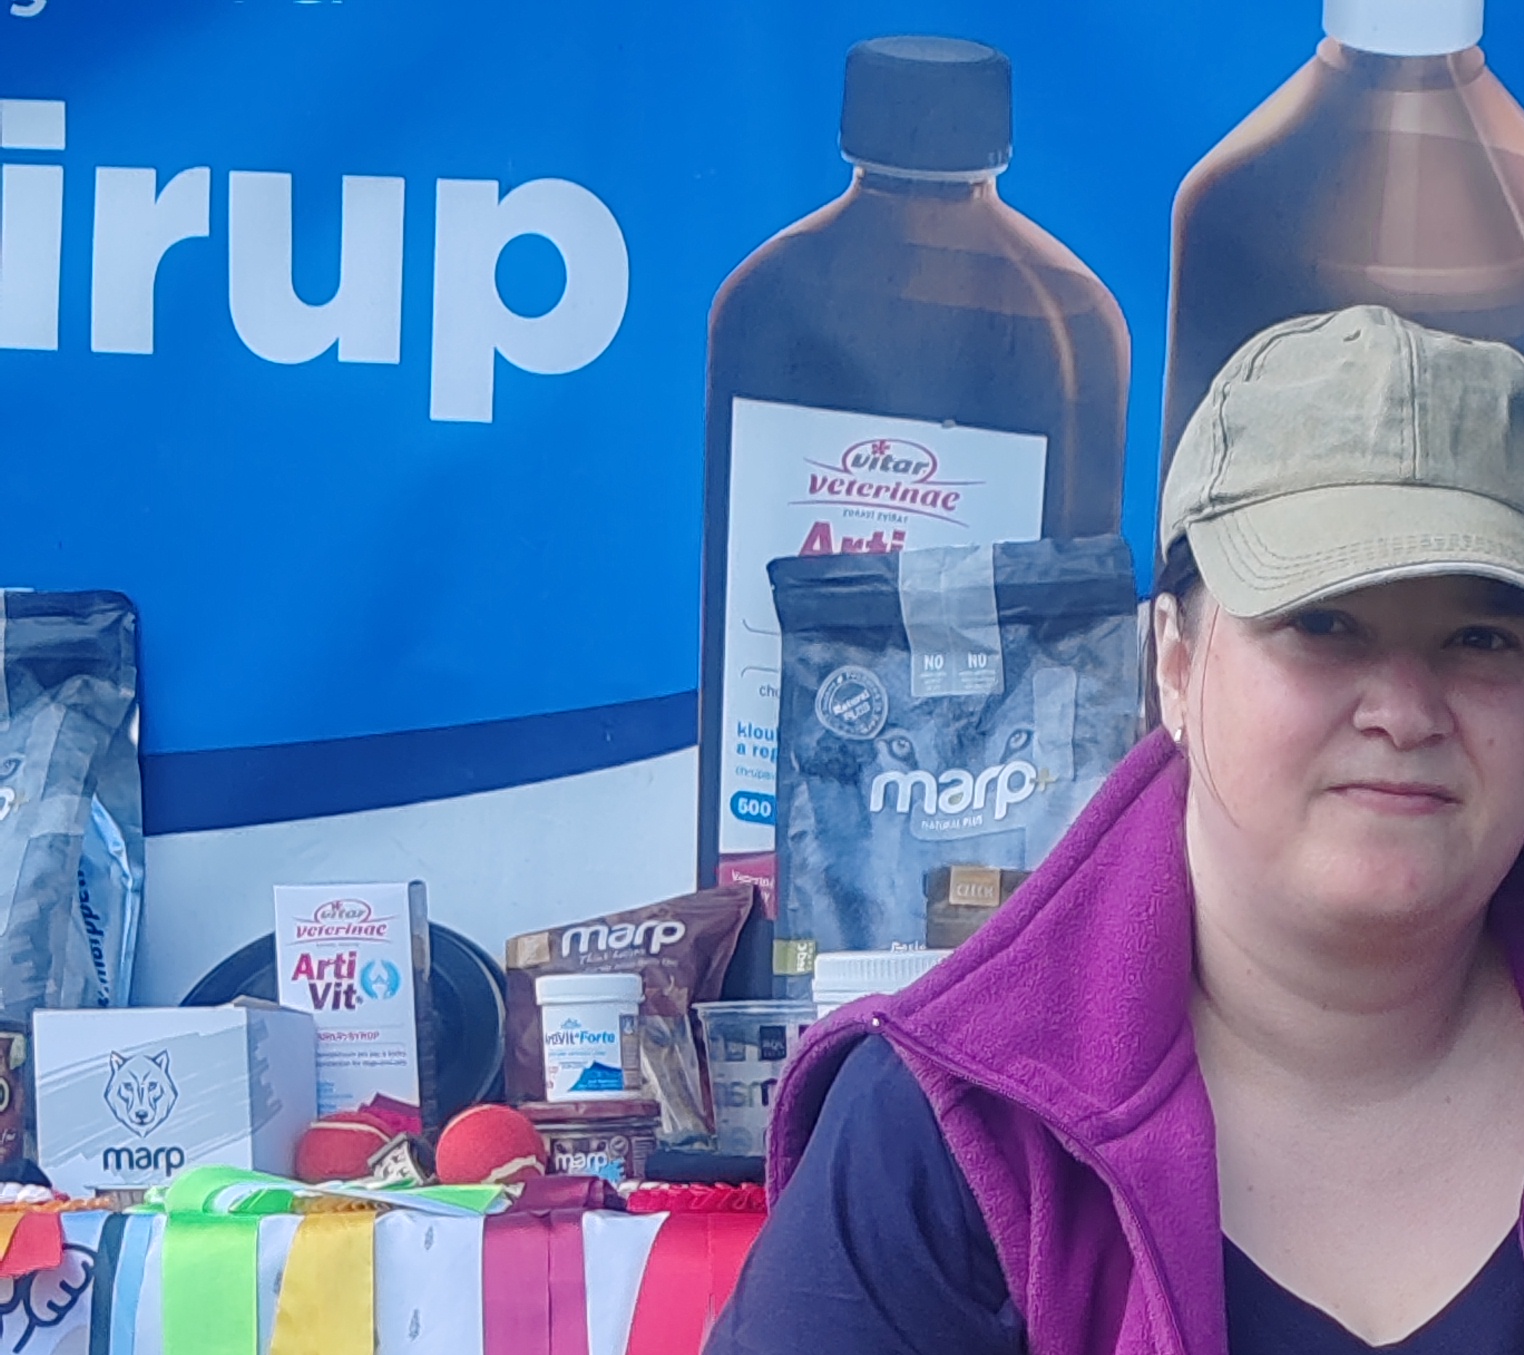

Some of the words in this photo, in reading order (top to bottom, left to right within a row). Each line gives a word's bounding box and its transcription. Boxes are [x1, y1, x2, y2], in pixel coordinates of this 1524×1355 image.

[0, 100, 629, 423] irup
[924, 654, 944, 670] NO
[737, 796, 772, 818] 500
[561, 919, 686, 959] marp
[291, 951, 357, 982] Arti
[103, 1146, 185, 1177] marp
[555, 1151, 608, 1173] marp
